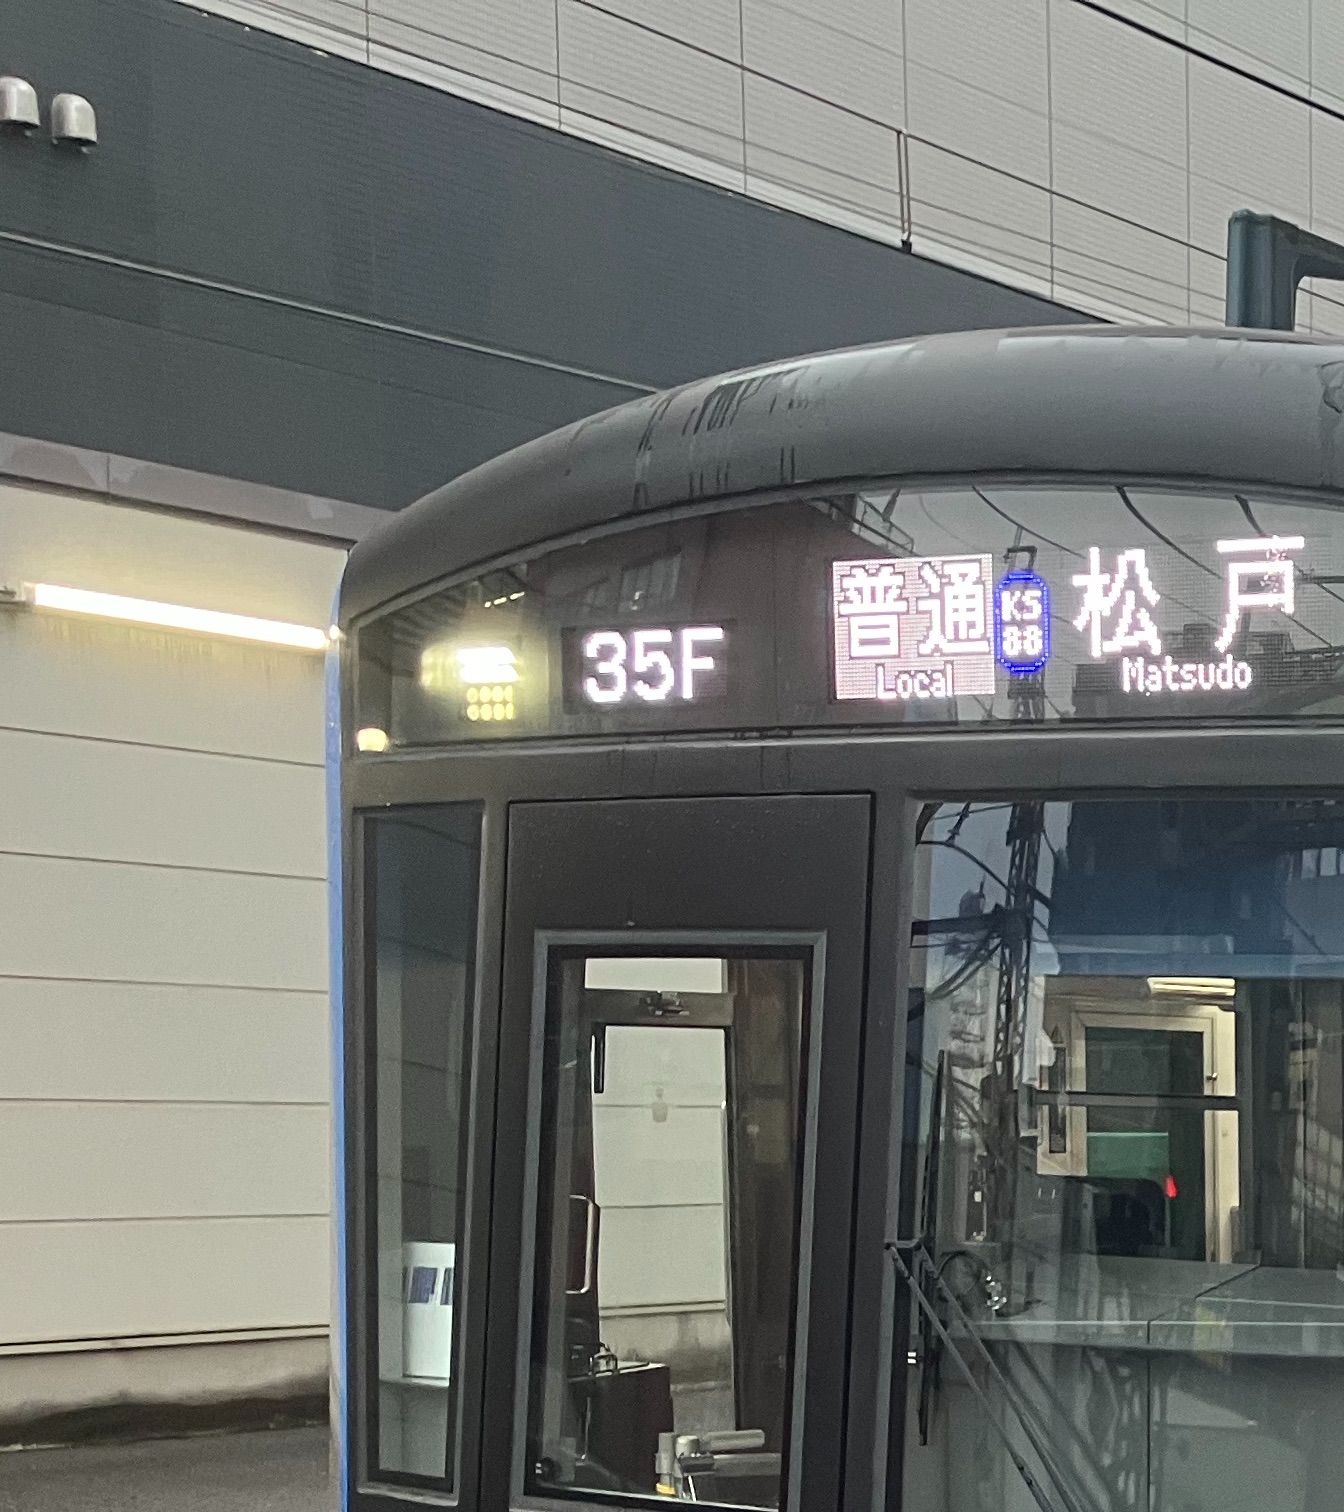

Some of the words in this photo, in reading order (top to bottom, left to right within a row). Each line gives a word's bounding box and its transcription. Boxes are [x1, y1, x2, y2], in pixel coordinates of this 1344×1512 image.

[838, 562, 990, 659] 普通
[1001, 589, 1042, 622] KS
[1072, 535, 1306, 660] 松戸
[584, 627, 725, 703] 35F
[876, 661, 954, 699] Local
[1121, 653, 1254, 694] Matsudo
